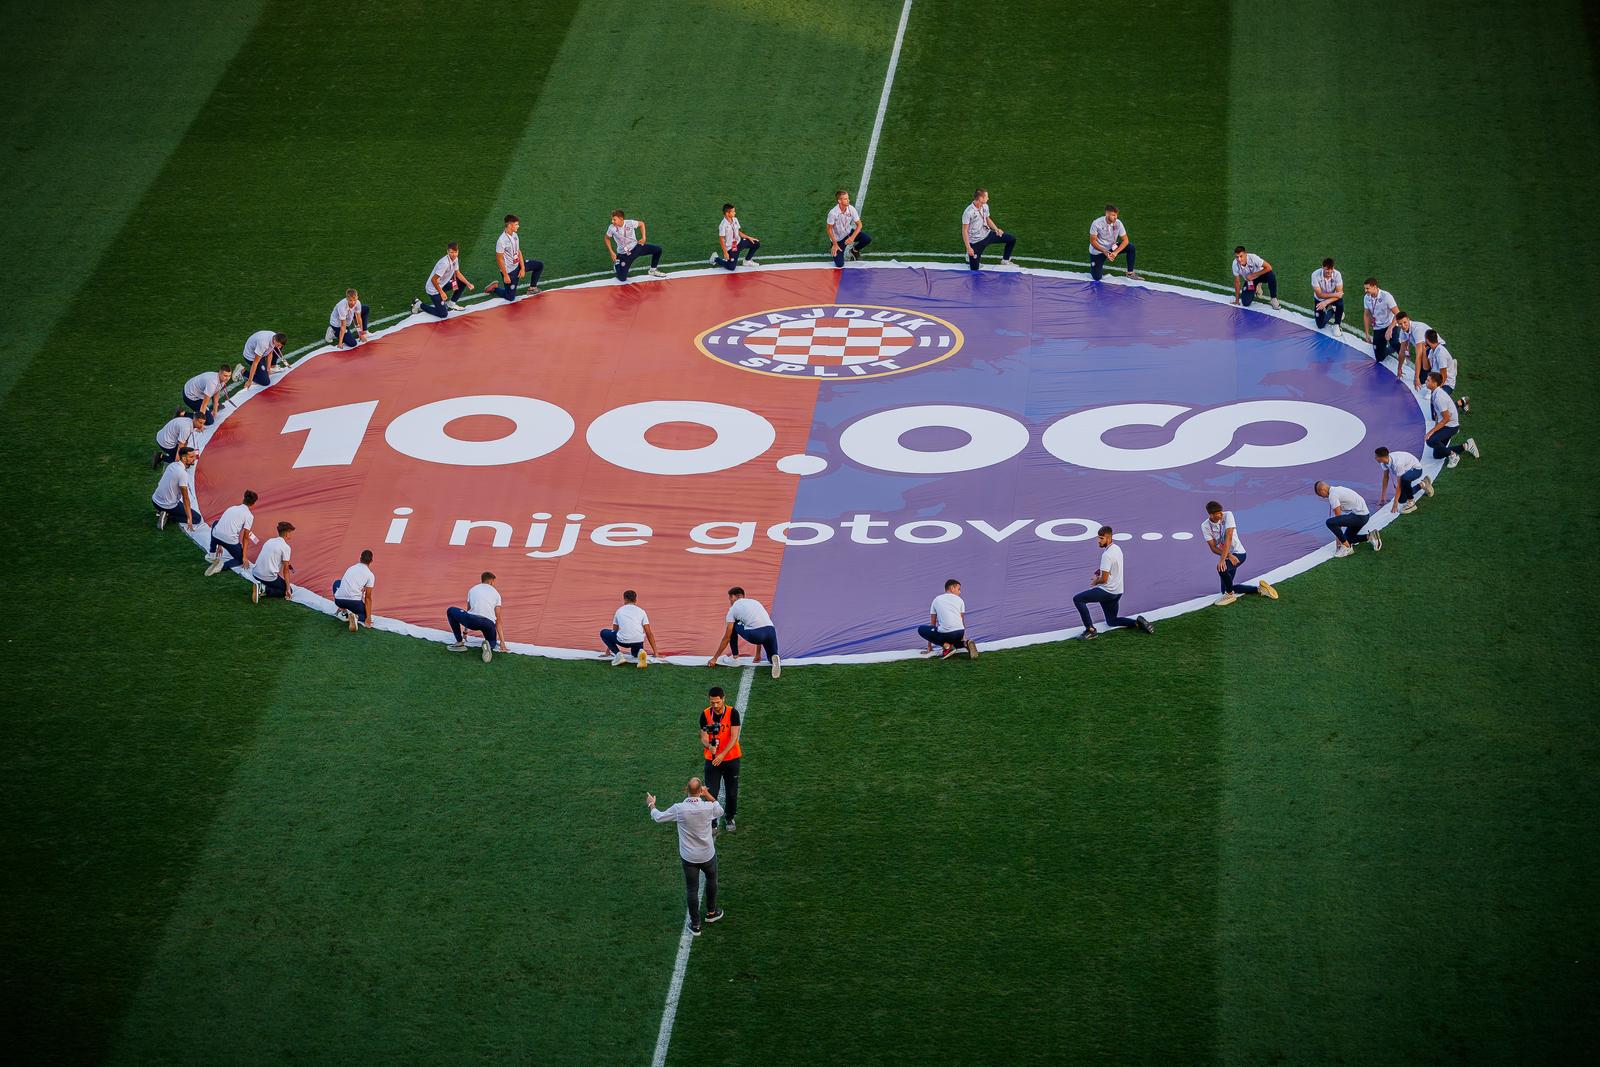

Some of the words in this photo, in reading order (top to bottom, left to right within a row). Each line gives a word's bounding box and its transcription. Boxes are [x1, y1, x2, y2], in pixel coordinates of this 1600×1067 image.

[727, 307, 937, 332] HAJDUK
[738, 357, 902, 377] SPLIT
[384, 507, 414, 545] i
[448, 512, 654, 559] nije
[685, 511, 1194, 555] gotovo...
